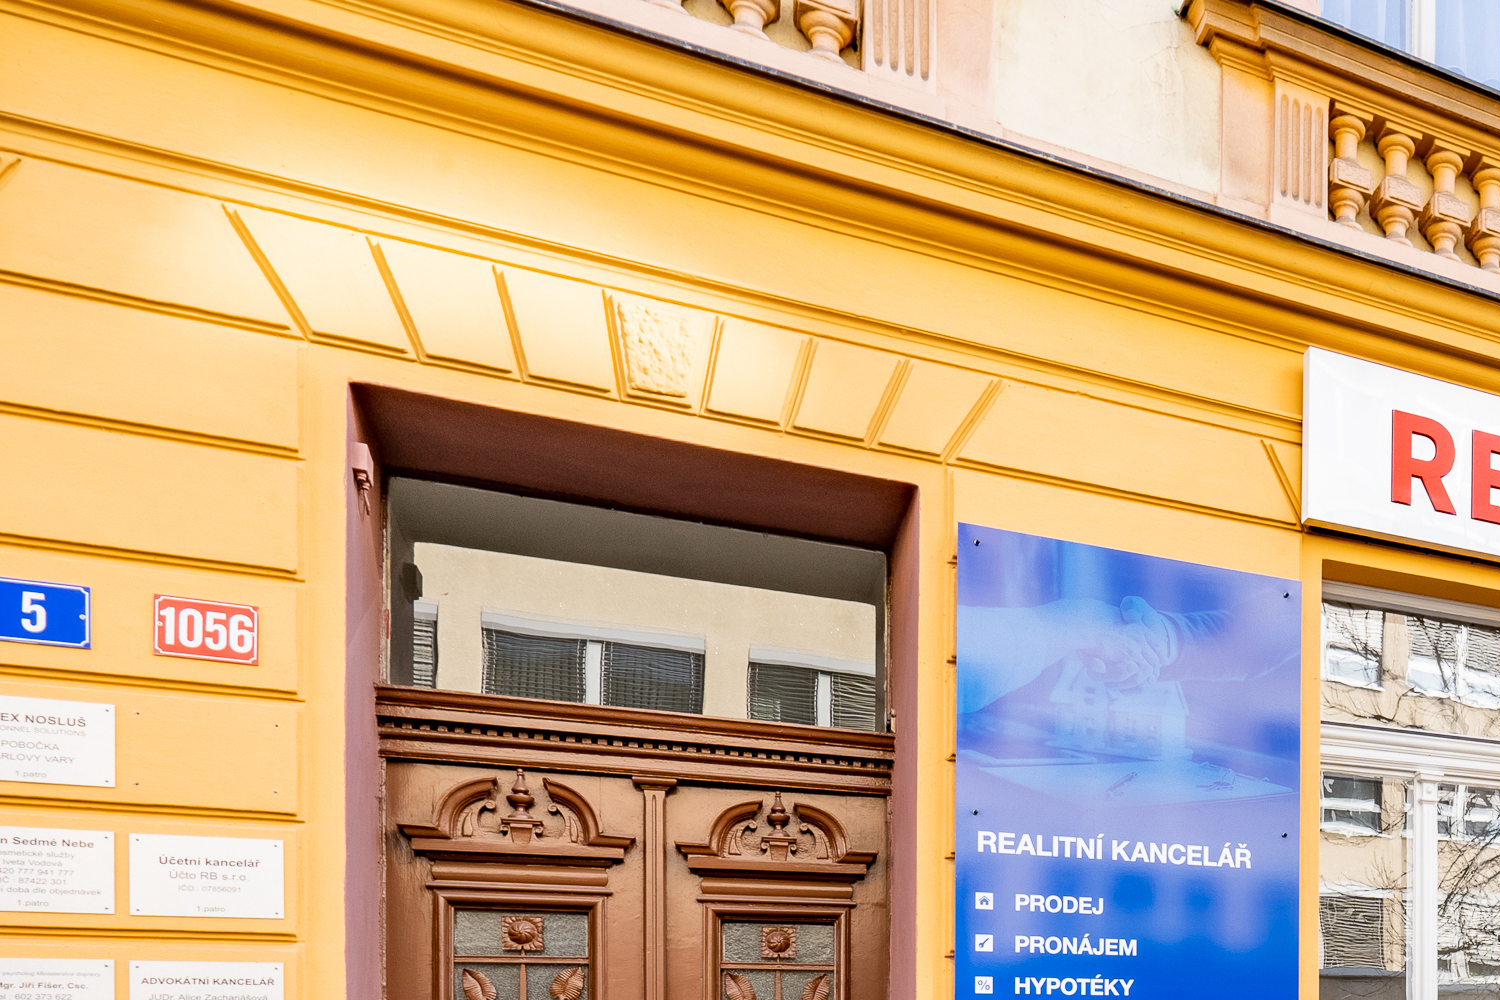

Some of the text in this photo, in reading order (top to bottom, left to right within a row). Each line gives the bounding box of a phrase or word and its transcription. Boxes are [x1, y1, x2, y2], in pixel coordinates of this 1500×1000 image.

[21, 591, 46, 633] 5
[160, 606, 253, 653] 1056
[25, 714, 86, 727] NOSLUŠ
[34, 727, 86, 737] SOLUTIONS
[1, 740, 60, 750] POBOČKA
[0, 752, 75, 763] RLOVY VARY
[13, 837, 57, 847] Sedmé
[62, 840, 94, 848] Nebe
[977, 830, 1252, 869] REALITNÍ KANCELÁŘ
[46, 852, 75, 860] služby
[159, 854, 260, 868] Účetní kancelář
[28, 859, 62, 867] Vodová
[169, 869, 196, 879] Účto
[200, 872, 218, 880] RB
[1015, 893, 1104, 915] PRODEJ
[1015, 933, 1138, 956] PRONÁJEM
[141, 976, 275, 986] ADVOKÁTNÍ KANCELÁŘ
[1014, 974, 1134, 996] HYPOTÉKY
